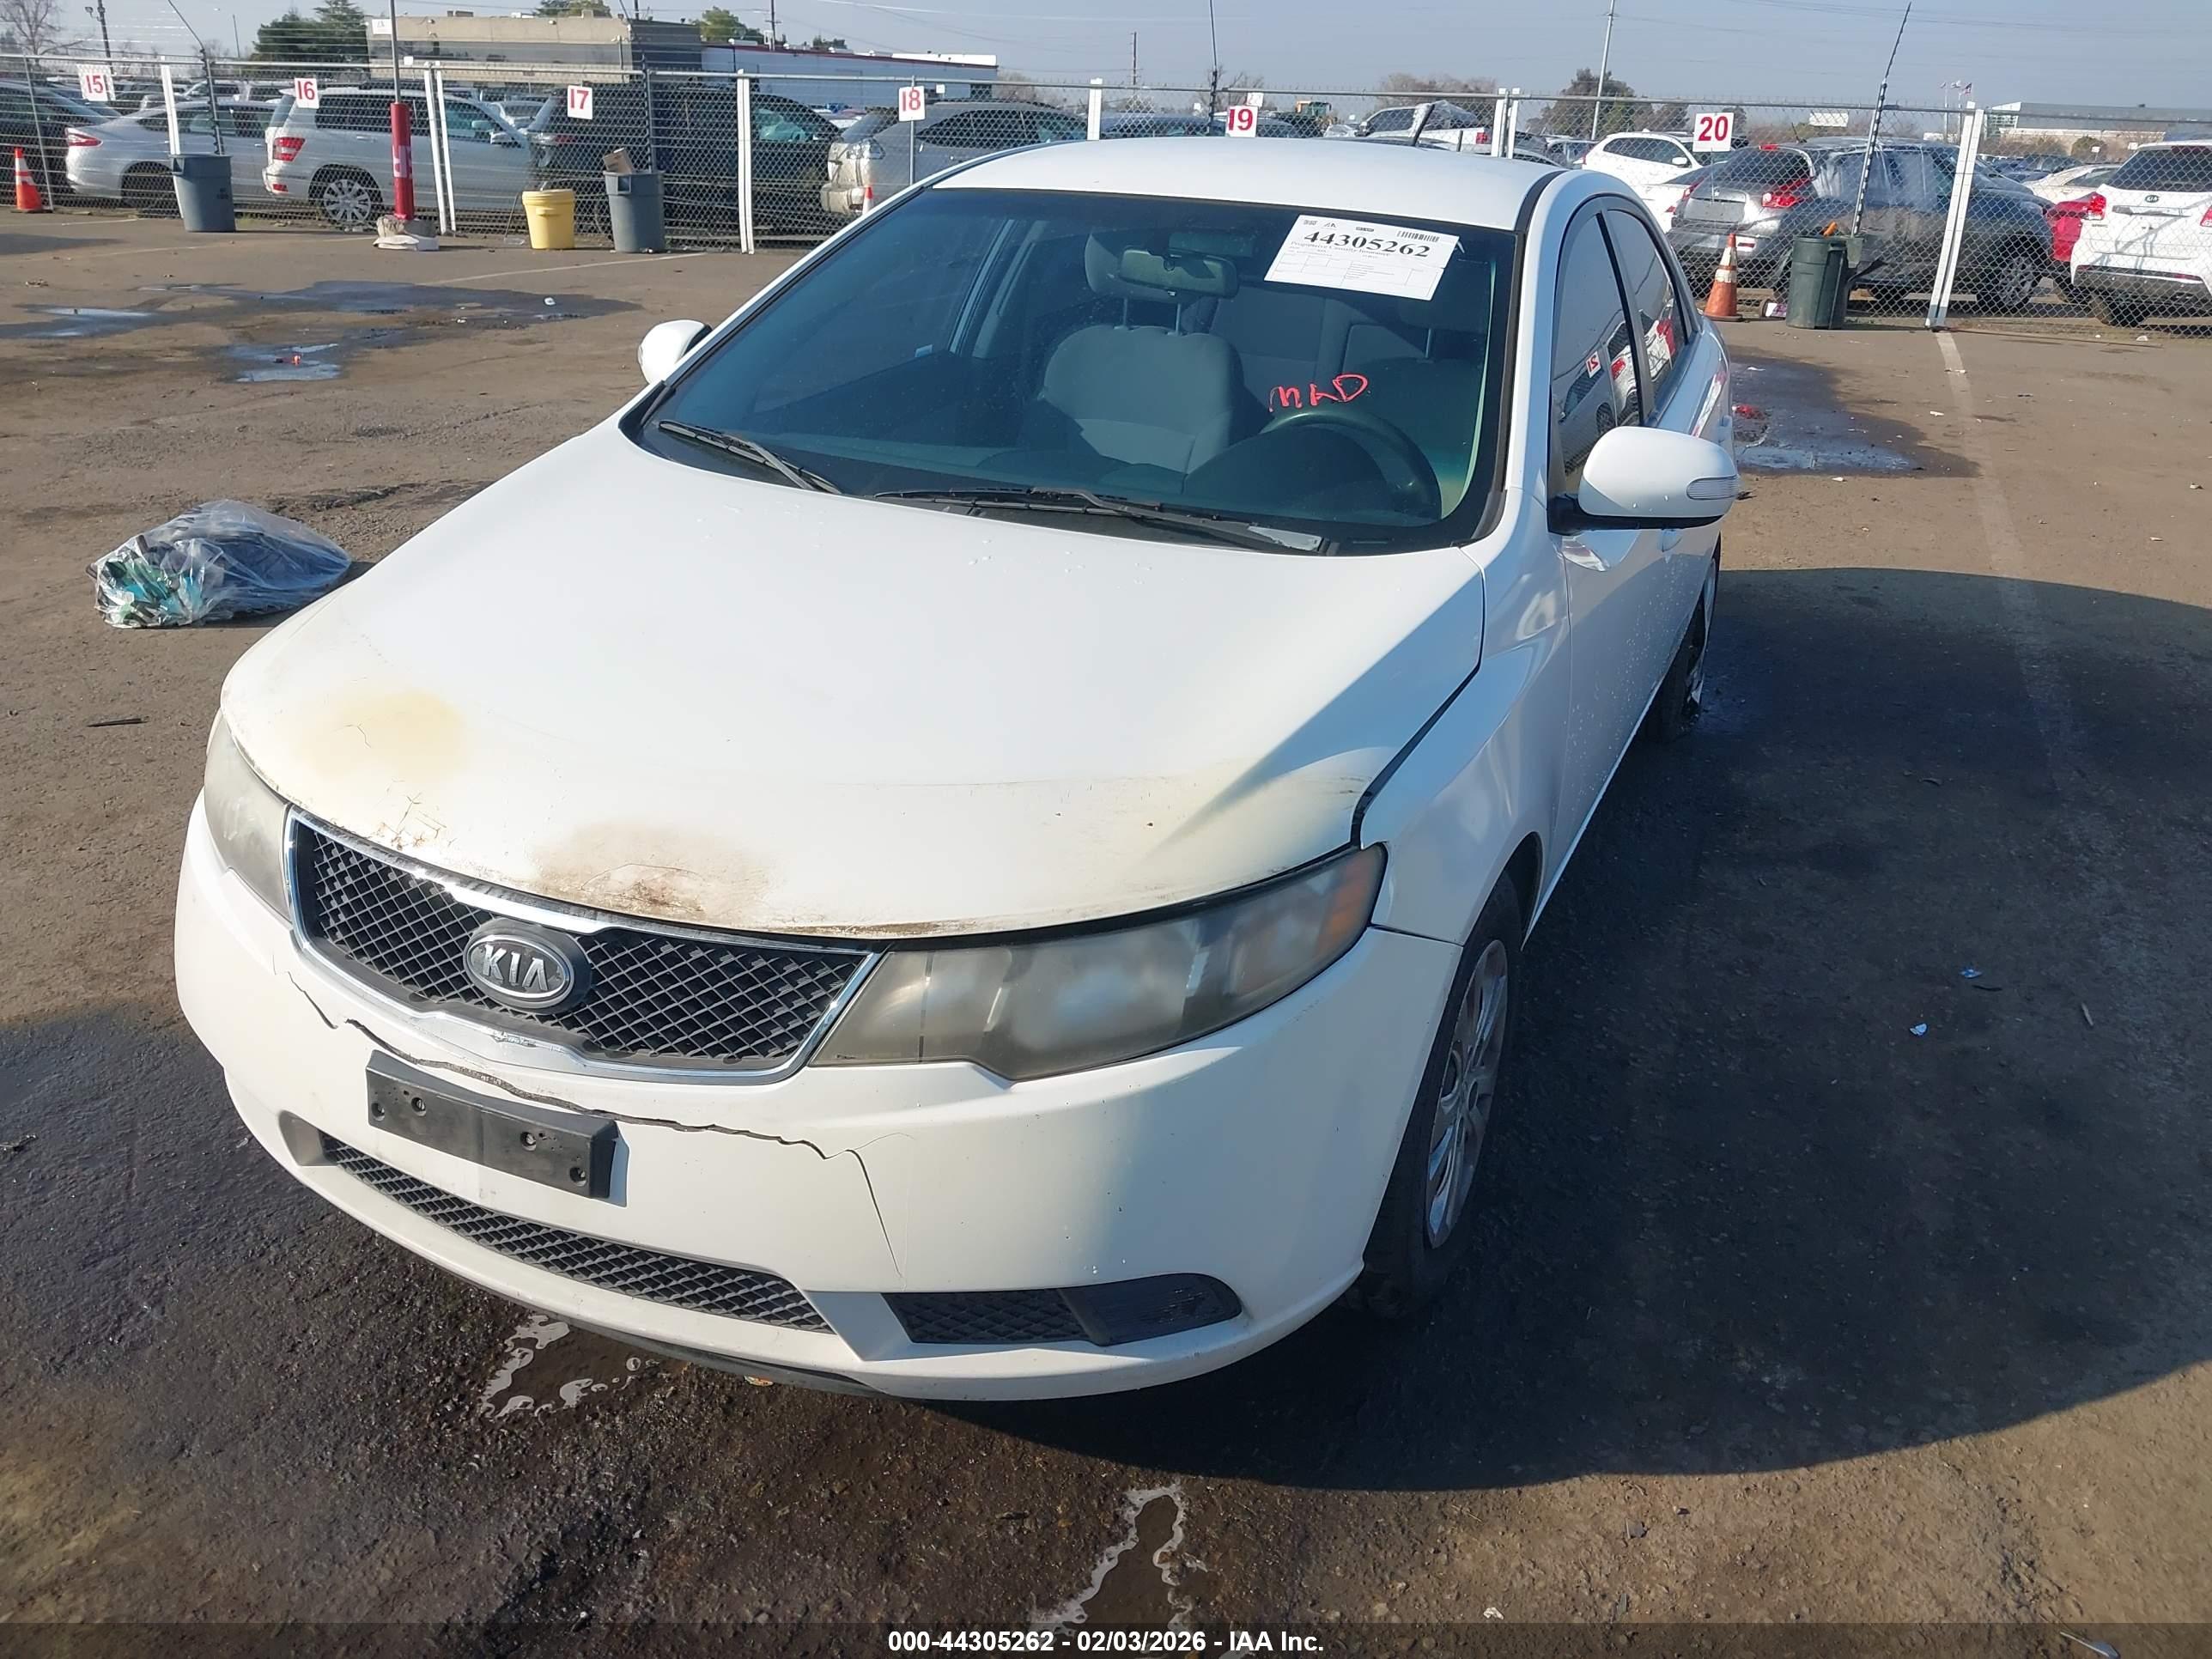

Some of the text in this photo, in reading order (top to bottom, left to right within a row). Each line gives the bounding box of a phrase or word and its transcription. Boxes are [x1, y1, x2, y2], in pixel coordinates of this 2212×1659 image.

[85, 75, 104, 94] 15
[297, 81, 315, 100] 16
[570, 88, 589, 110] 17
[902, 88, 921, 112] 18
[1228, 108, 1254, 131] 19
[1698, 116, 1729, 142] 20
[1304, 231, 1431, 258] 44305262
[483, 943, 550, 992] KIA
